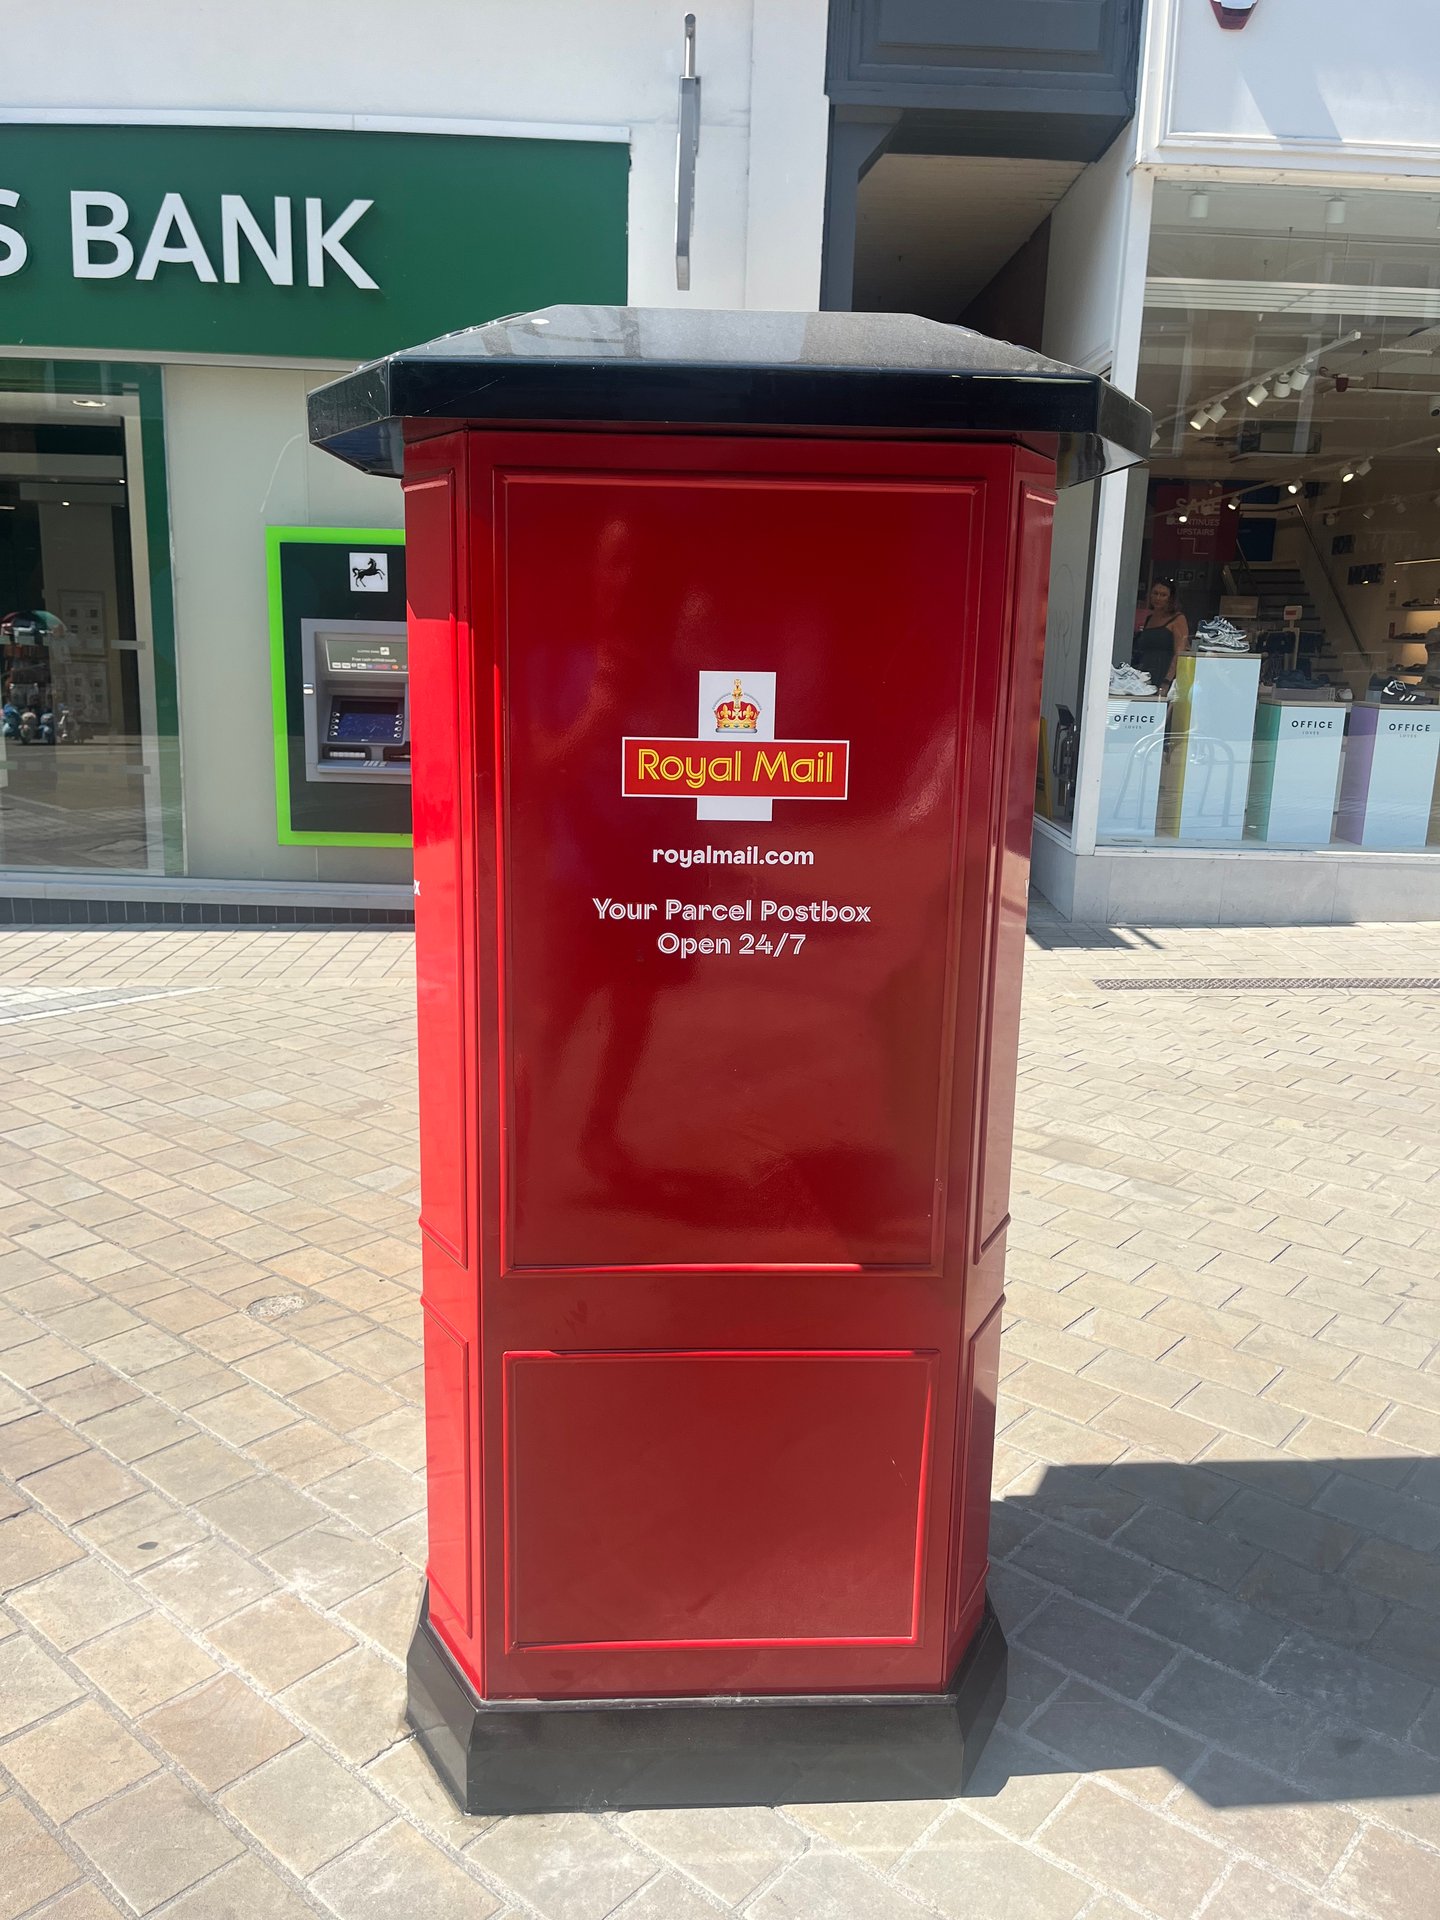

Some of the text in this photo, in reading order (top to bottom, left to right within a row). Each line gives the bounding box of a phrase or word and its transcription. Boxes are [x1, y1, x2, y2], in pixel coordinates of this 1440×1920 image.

[70, 190, 380, 290] BANK
[1113, 714, 1155, 724] OFFICE
[1291, 720, 1333, 729] OFFICE
[1388, 723, 1431, 732] OFFICE
[637, 748, 834, 789] Royal Mail
[652, 845, 815, 868] royalmail.com
[592, 898, 872, 923] Your Parcel Postbox
[657, 932, 807, 959] Open 24/7
